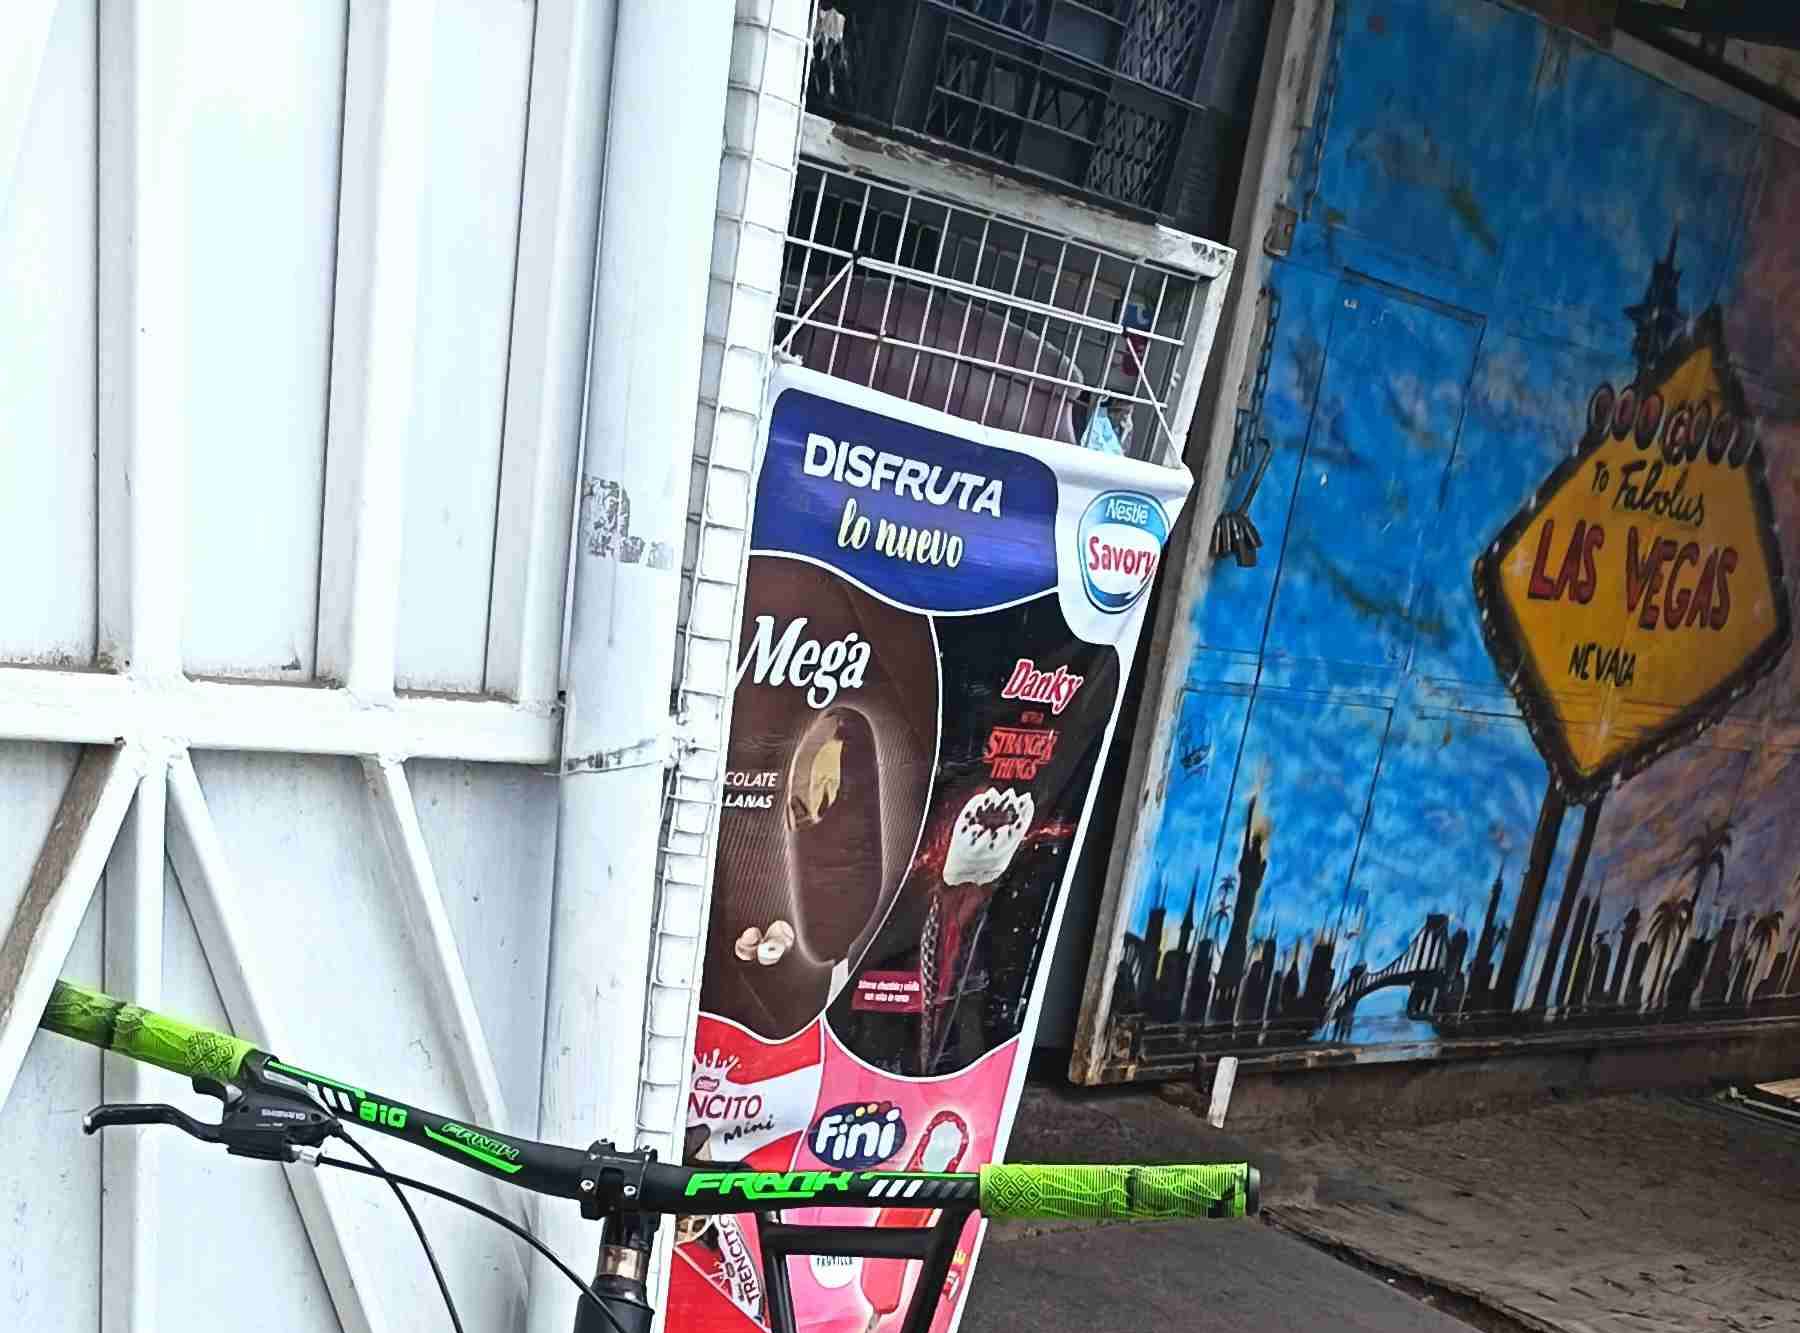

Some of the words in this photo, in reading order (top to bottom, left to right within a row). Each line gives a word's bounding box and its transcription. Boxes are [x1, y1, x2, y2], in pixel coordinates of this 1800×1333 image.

[803, 433, 1003, 518] DISFRUTA
[837, 498, 872, 548] lo
[873, 521, 964, 568] nuevo
[1088, 535, 1158, 584] Savory
[1528, 519, 1605, 605] LAS
[1625, 526, 1739, 631] VEGAS
[736, 615, 871, 709] Mega
[1001, 658, 1084, 714] Danky
[816, 1109, 900, 1160] Fini
[684, 1171, 851, 1200] FRANK
